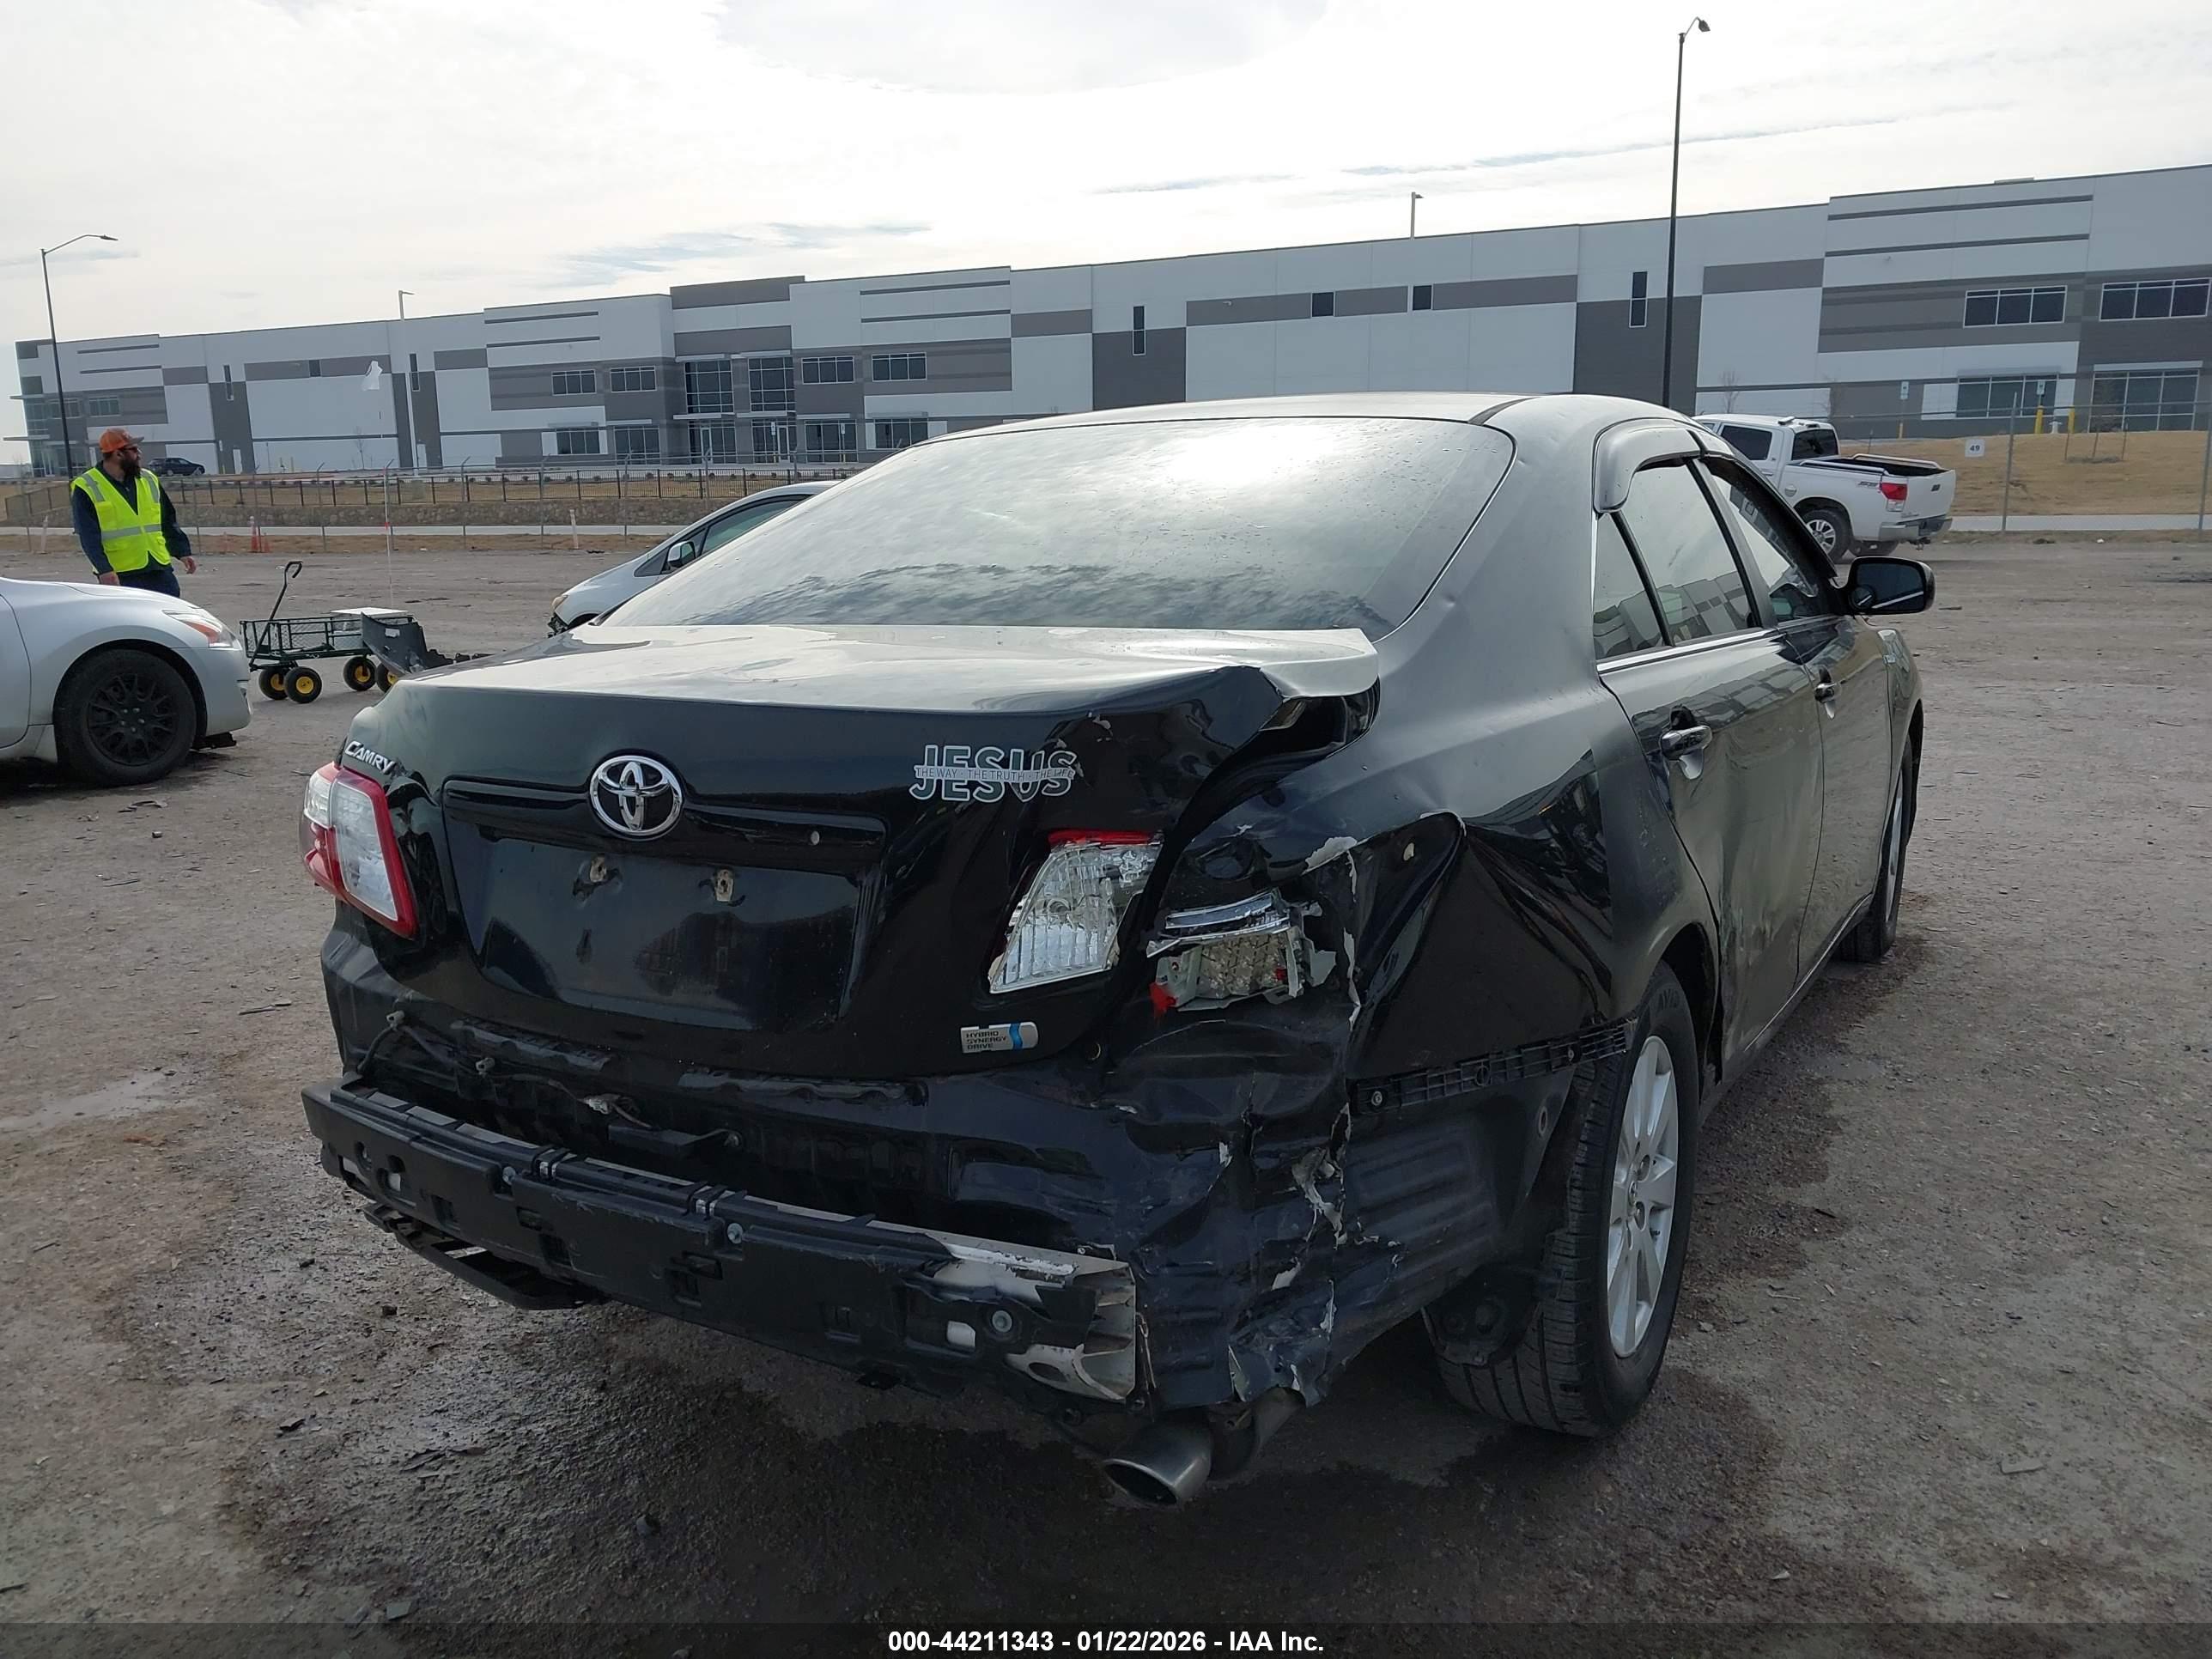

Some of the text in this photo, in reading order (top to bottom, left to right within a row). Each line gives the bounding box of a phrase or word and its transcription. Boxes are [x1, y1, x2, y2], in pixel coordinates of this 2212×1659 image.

[909, 744, 1078, 803] JESUS
[915, 767, 1074, 781] THE WAY THE TRUTH THE LIFE
